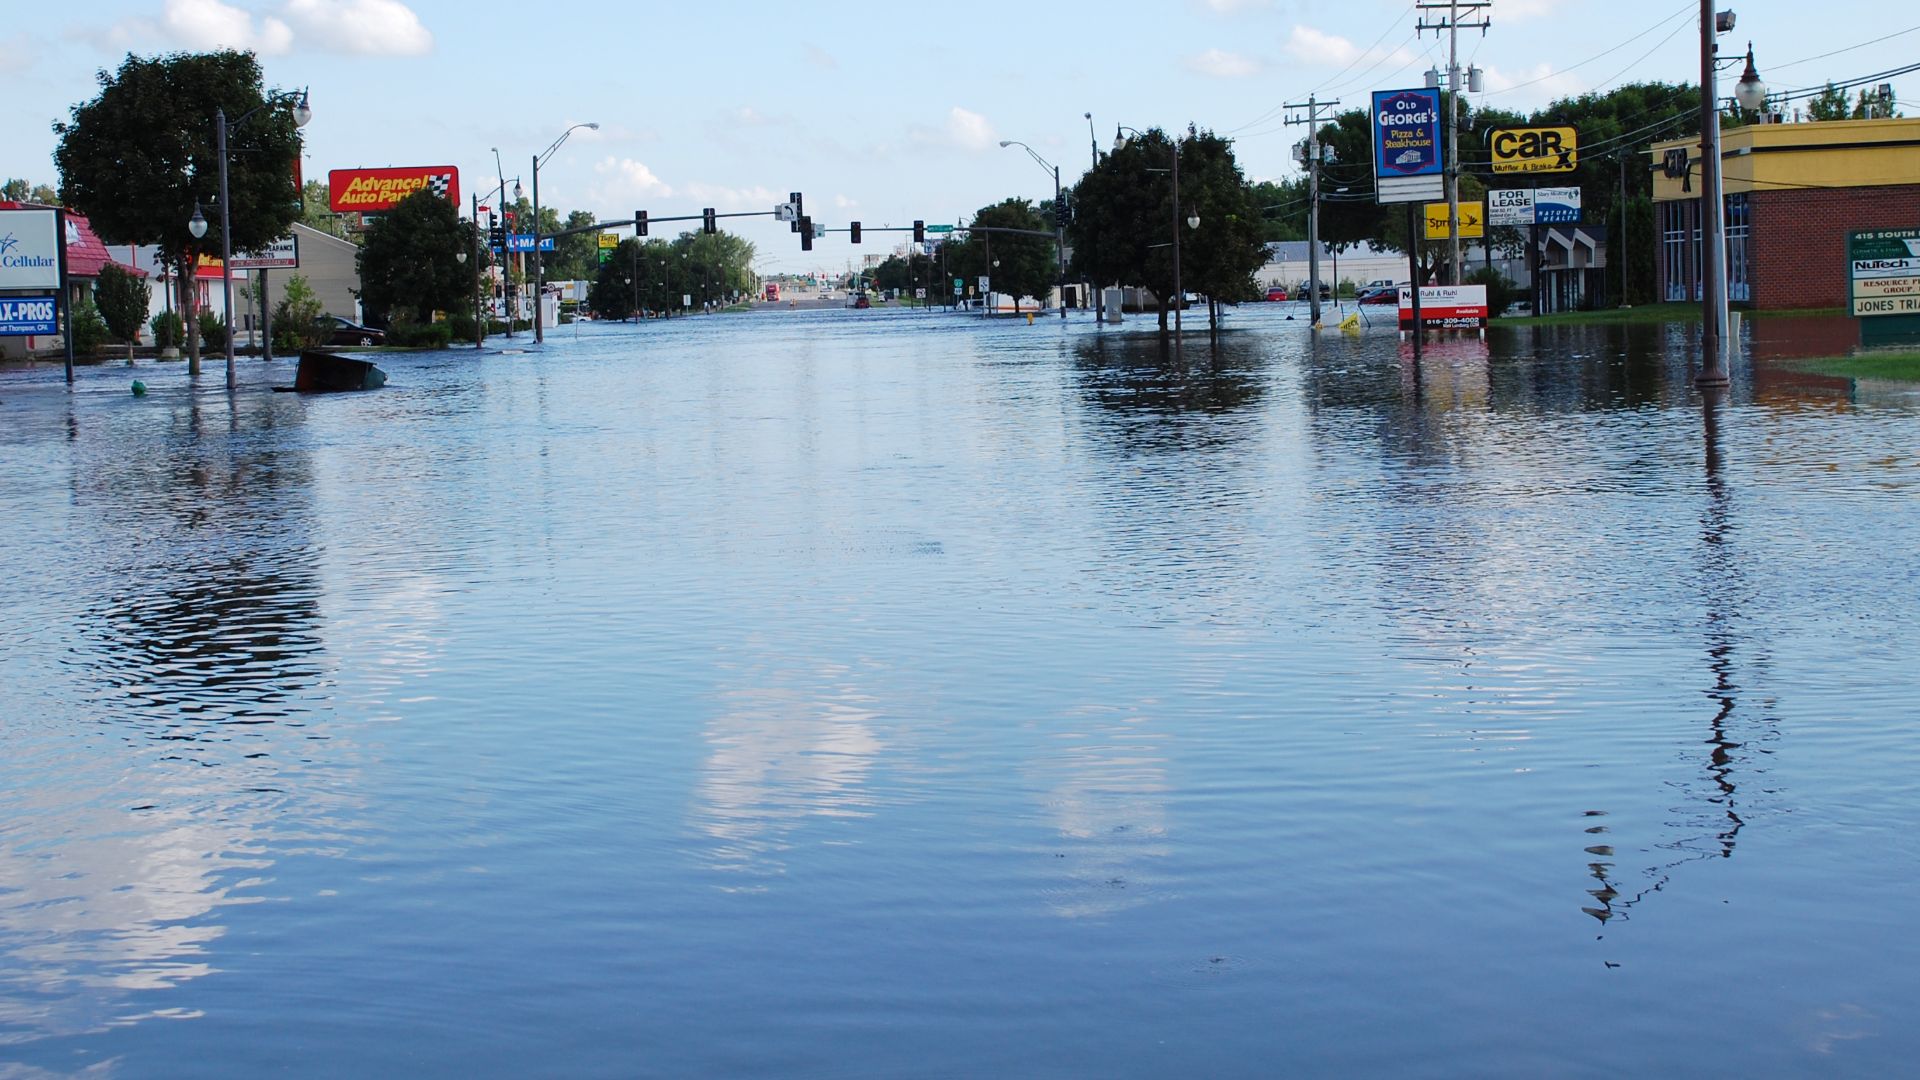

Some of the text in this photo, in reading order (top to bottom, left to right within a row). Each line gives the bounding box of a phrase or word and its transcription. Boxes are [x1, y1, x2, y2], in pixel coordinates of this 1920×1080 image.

[1396, 100, 1416, 110] OLD
[1378, 108, 1437, 126] GEORGE'S
[1391, 128, 1424, 138] Pizza &
[1385, 139, 1431, 148] Steakhouse
[338, 189, 413, 204] Auto Part
[1492, 198, 1531, 207] LEASE
[1430, 216, 1461, 230] Sprit
[1877, 230, 1915, 239] SOUTH
[3, 255, 55, 268] Cellular
[1855, 260, 1909, 270] NuTech
[1863, 279, 1909, 287] RESOURCE
[1857, 300, 1894, 312] JONES
